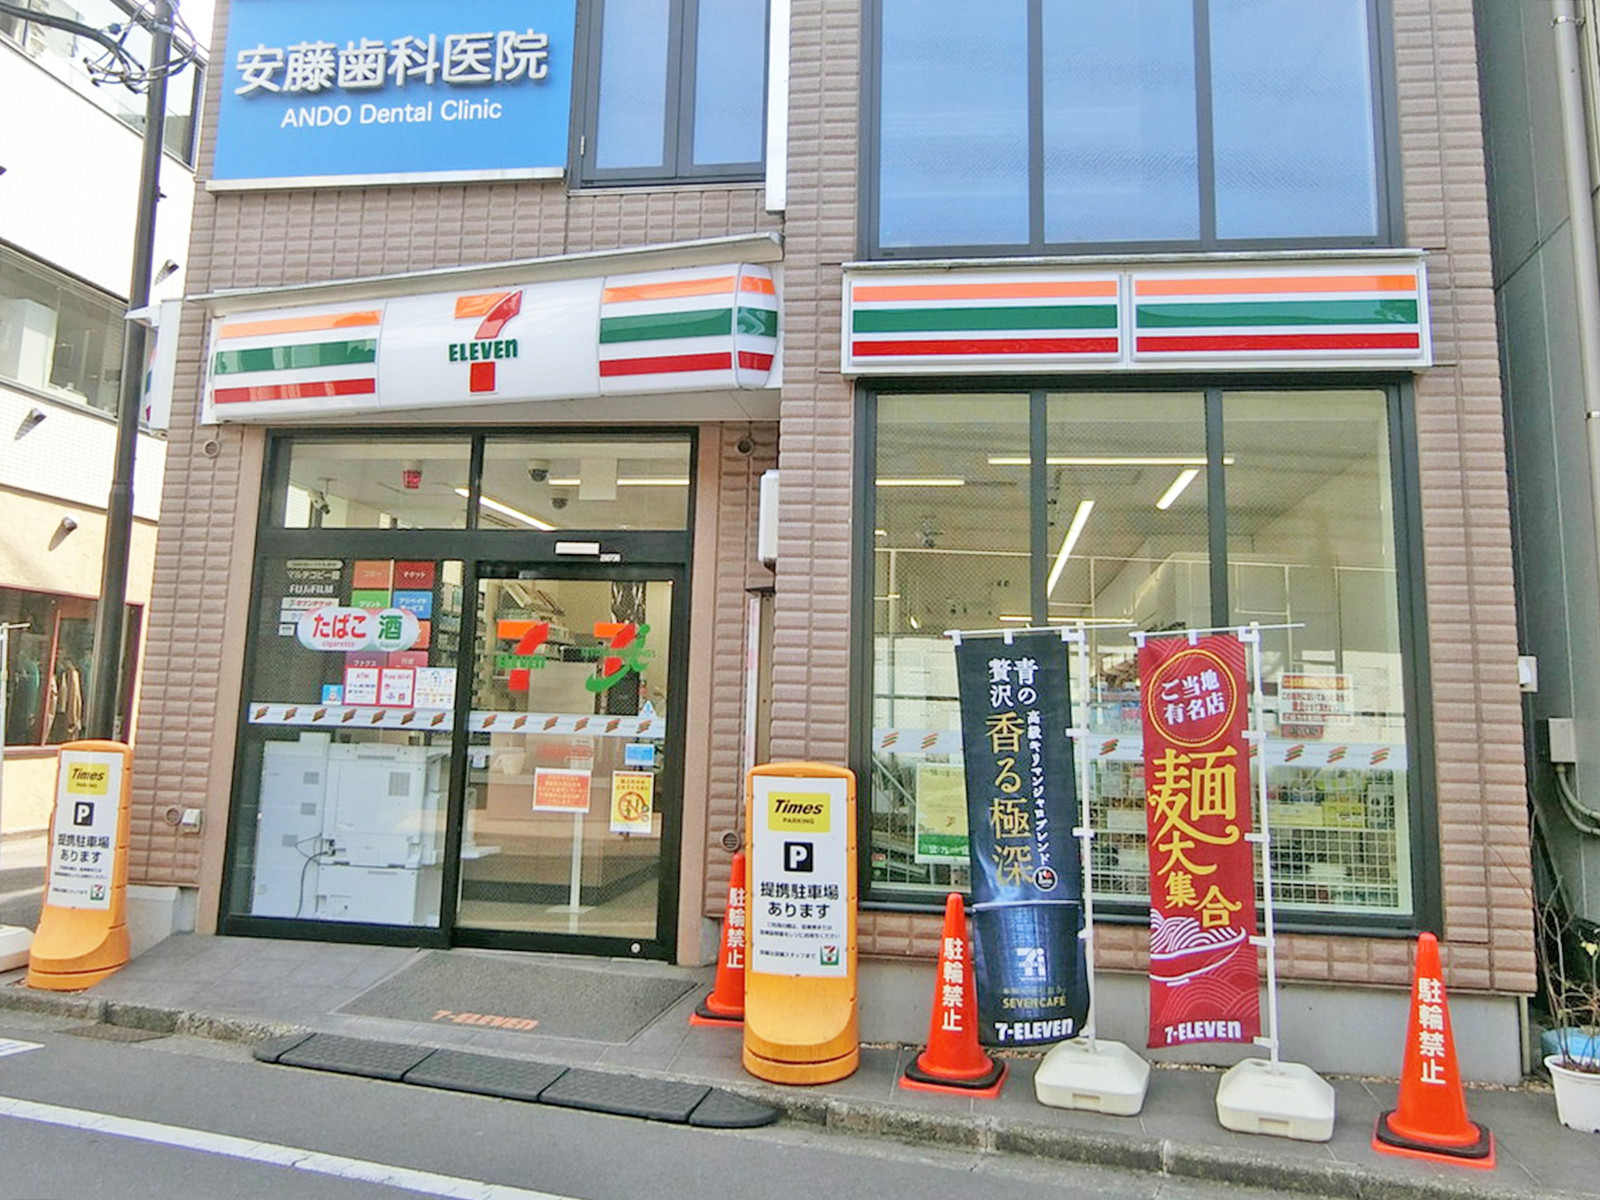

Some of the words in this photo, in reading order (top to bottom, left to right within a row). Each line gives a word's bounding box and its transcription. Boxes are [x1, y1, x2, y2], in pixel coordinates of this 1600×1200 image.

[234, 28, 548, 95] 安藤歯科医院
[280, 105, 351, 129] ANDO
[360, 102, 432, 124] Dental
[440, 99, 502, 121] Clinic
[403, 571, 426, 579] チケット
[313, 614, 367, 639] たばこ
[378, 614, 403, 640] 酒
[1013, 657, 1039, 705] 青の
[1161, 669, 1220, 701] ご当地
[1163, 692, 1225, 725] 有名店
[72, 769, 105, 782] Times
[774, 799, 824, 815] Times
[985, 711, 1034, 887] 香る極深
[76, 804, 91, 823] P
[58, 833, 110, 849] 提携駐車場
[60, 850, 102, 863] あります
[789, 845, 808, 869] P
[760, 882, 839, 900] 提携駐車場
[768, 902, 830, 918] あります
[726, 888, 745, 969] 駐輪禁止
[942, 937, 963, 1031] 駐輪禁止
[1418, 977, 1446, 1085] 駐輪禁止
